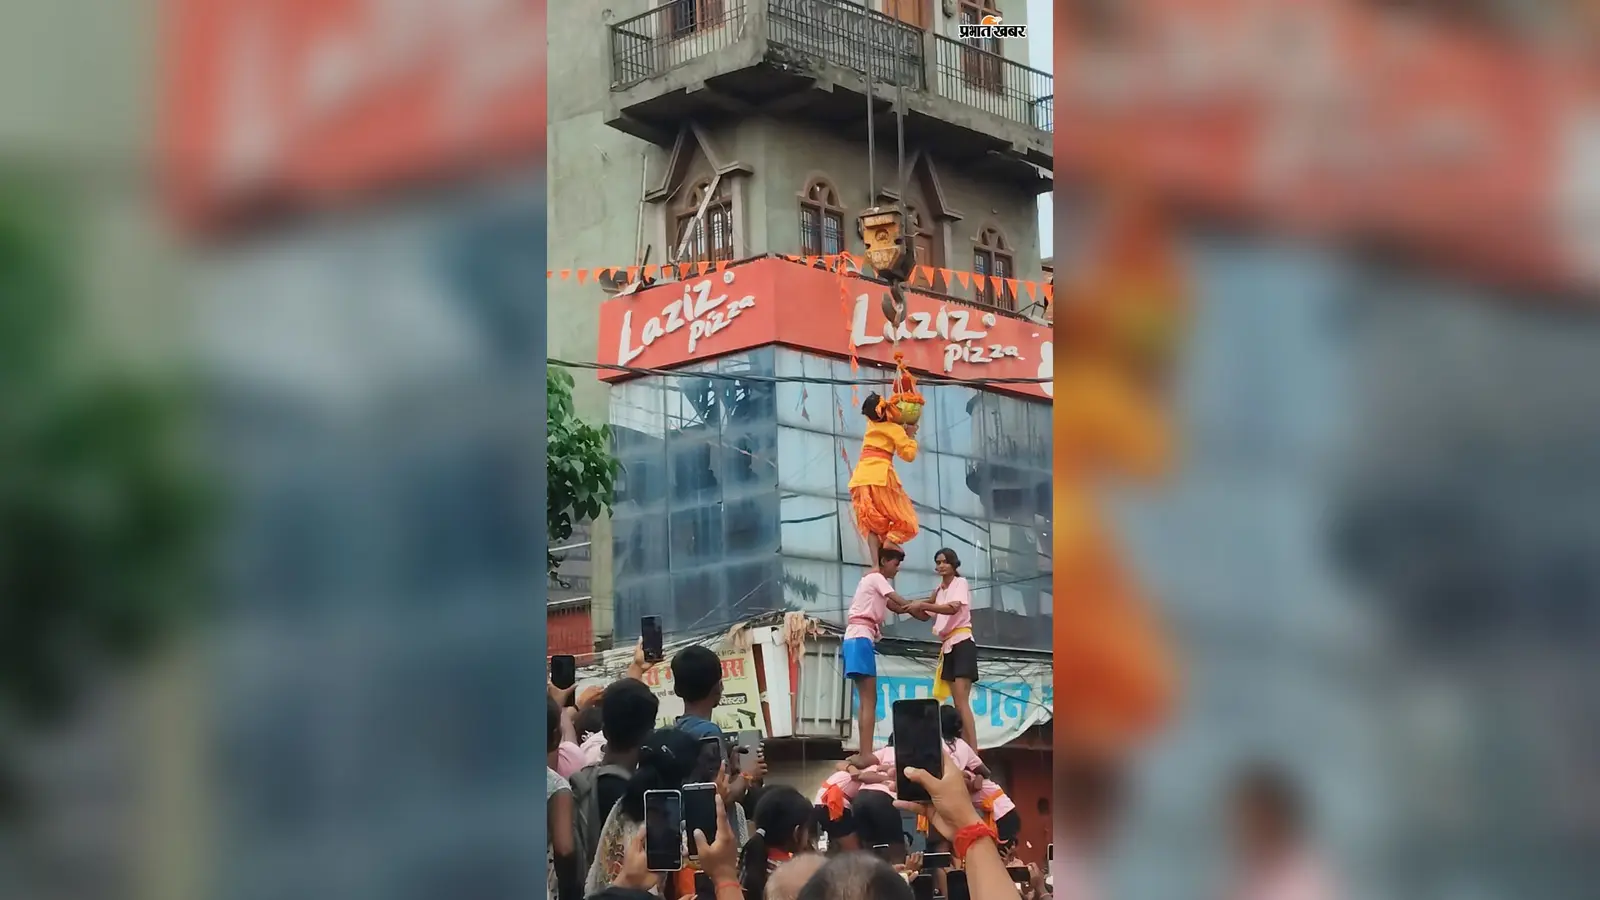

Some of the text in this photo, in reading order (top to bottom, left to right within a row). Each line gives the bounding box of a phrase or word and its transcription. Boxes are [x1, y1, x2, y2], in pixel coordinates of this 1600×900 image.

[618, 280, 728, 366] Laziz
[688, 295, 755, 353] pizza
[944, 341, 1024, 372] pizza
